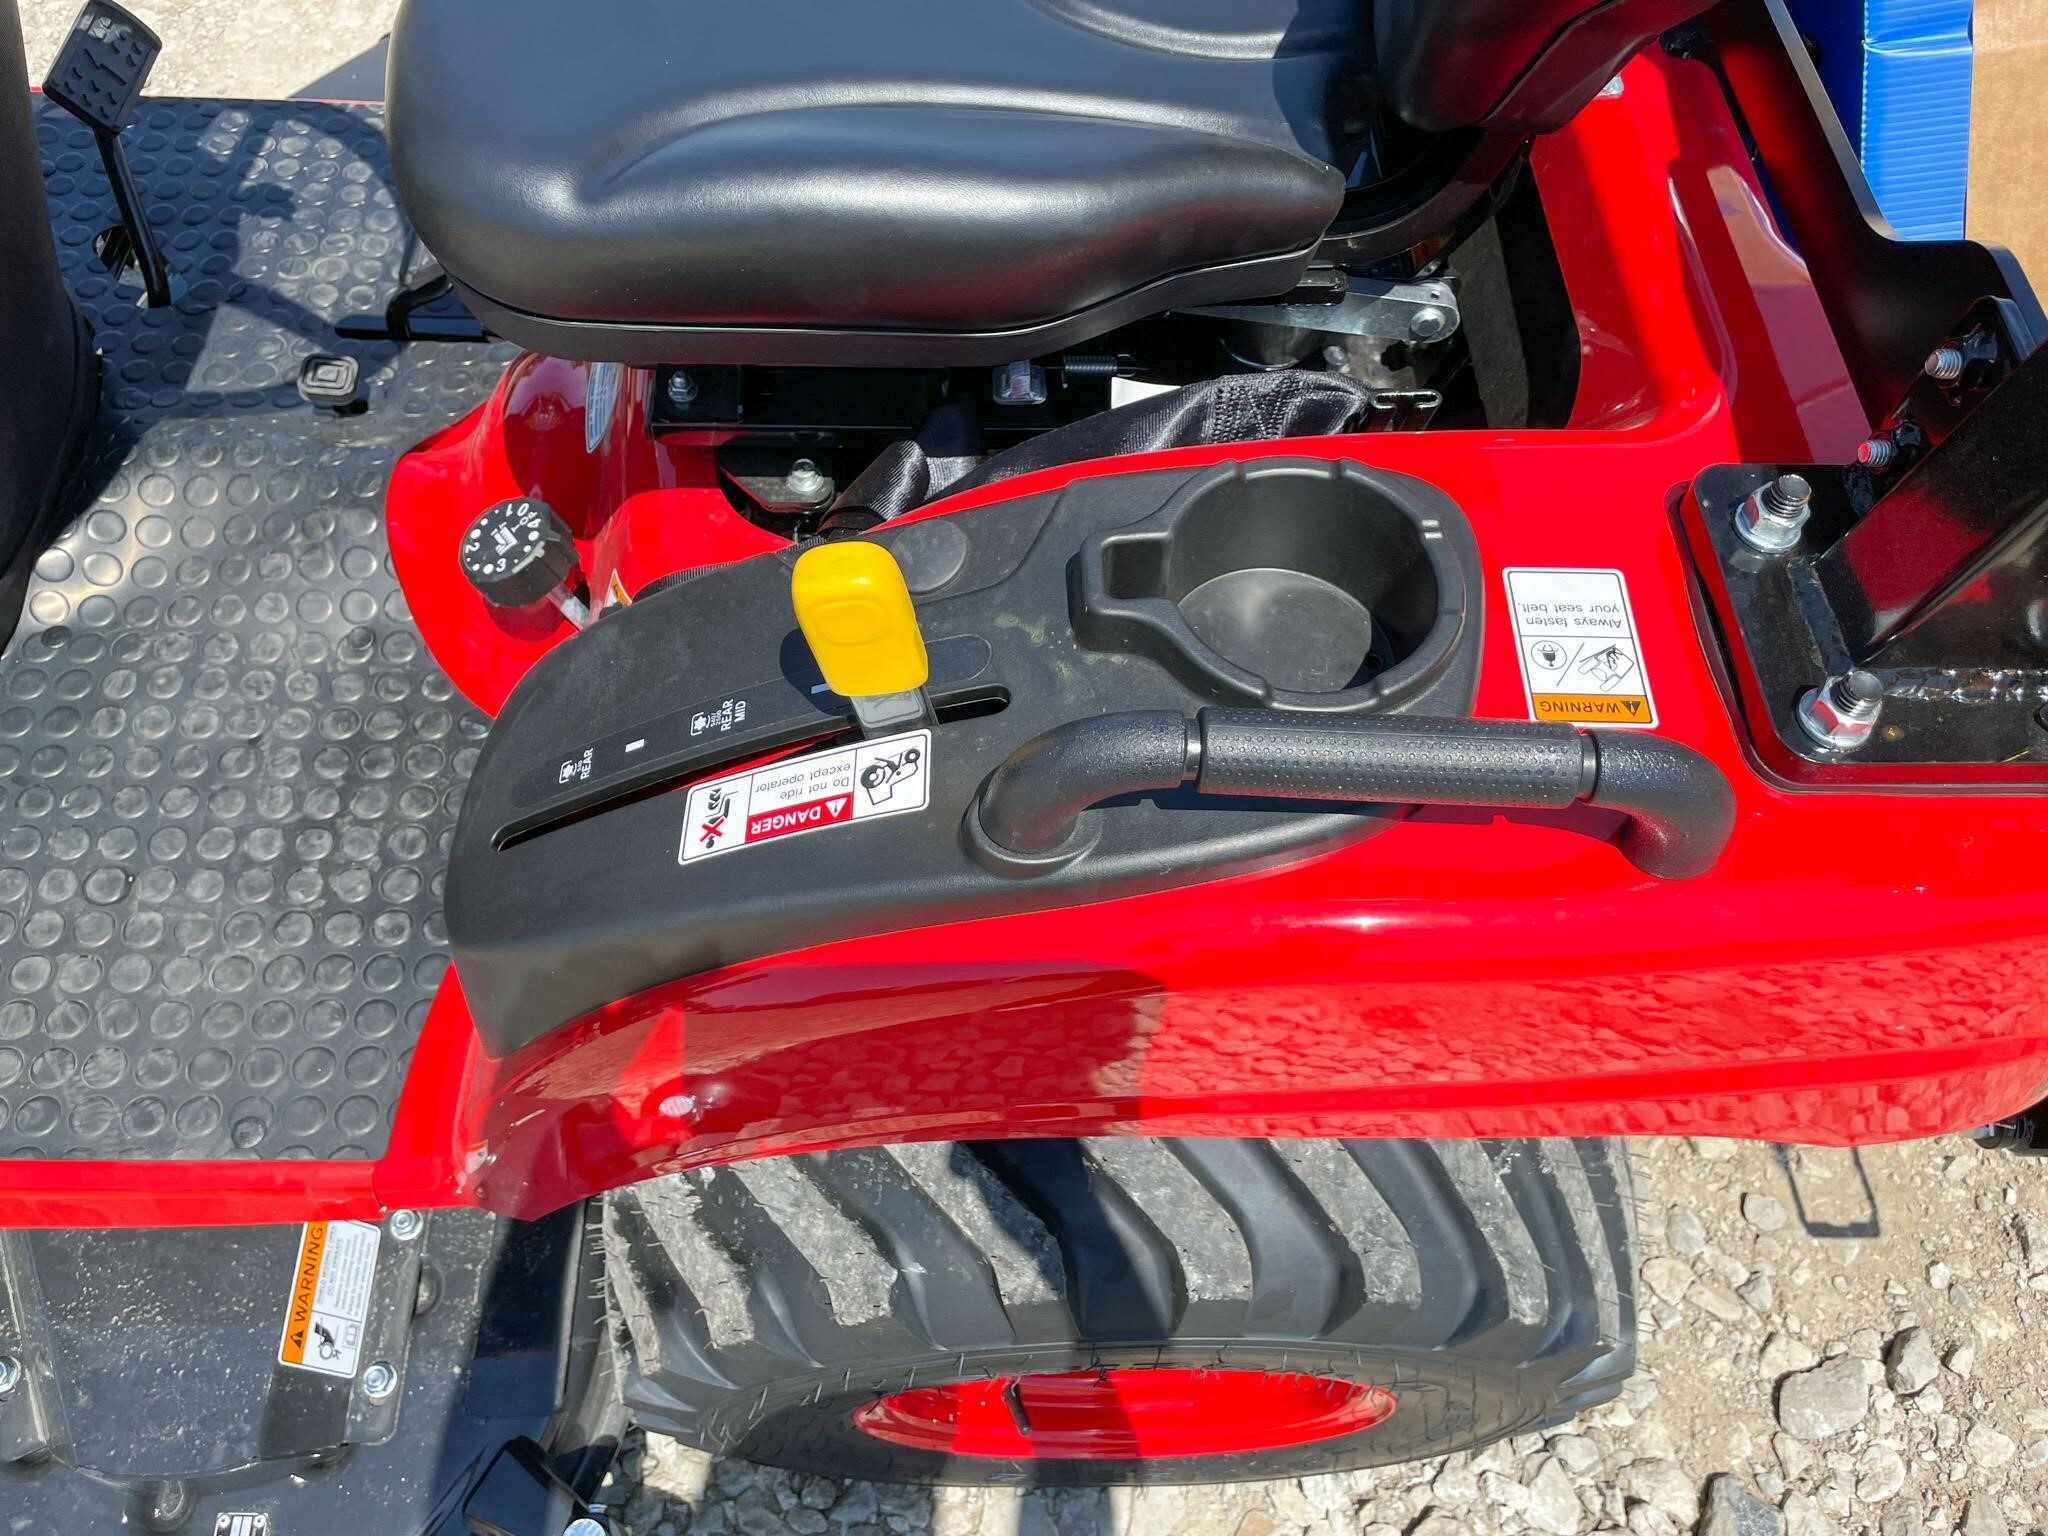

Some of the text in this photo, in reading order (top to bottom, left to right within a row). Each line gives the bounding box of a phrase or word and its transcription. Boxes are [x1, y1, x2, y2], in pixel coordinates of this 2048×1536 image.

[465, 542, 480, 553] 2
[496, 558, 507, 572] 3
[1517, 602, 1619, 614] your seat belt.
[1526, 617, 1621, 629] Always fasten
[720, 698, 734, 732] REAR
[734, 700, 746, 723] MID
[1539, 701, 1621, 713] WARNING
[580, 747, 594, 780] REAR
[755, 763, 851, 793] except operator
[780, 776, 850, 801] Do not ride
[750, 805, 822, 835] DANGER
[294, 1226, 323, 1322] WARNING
